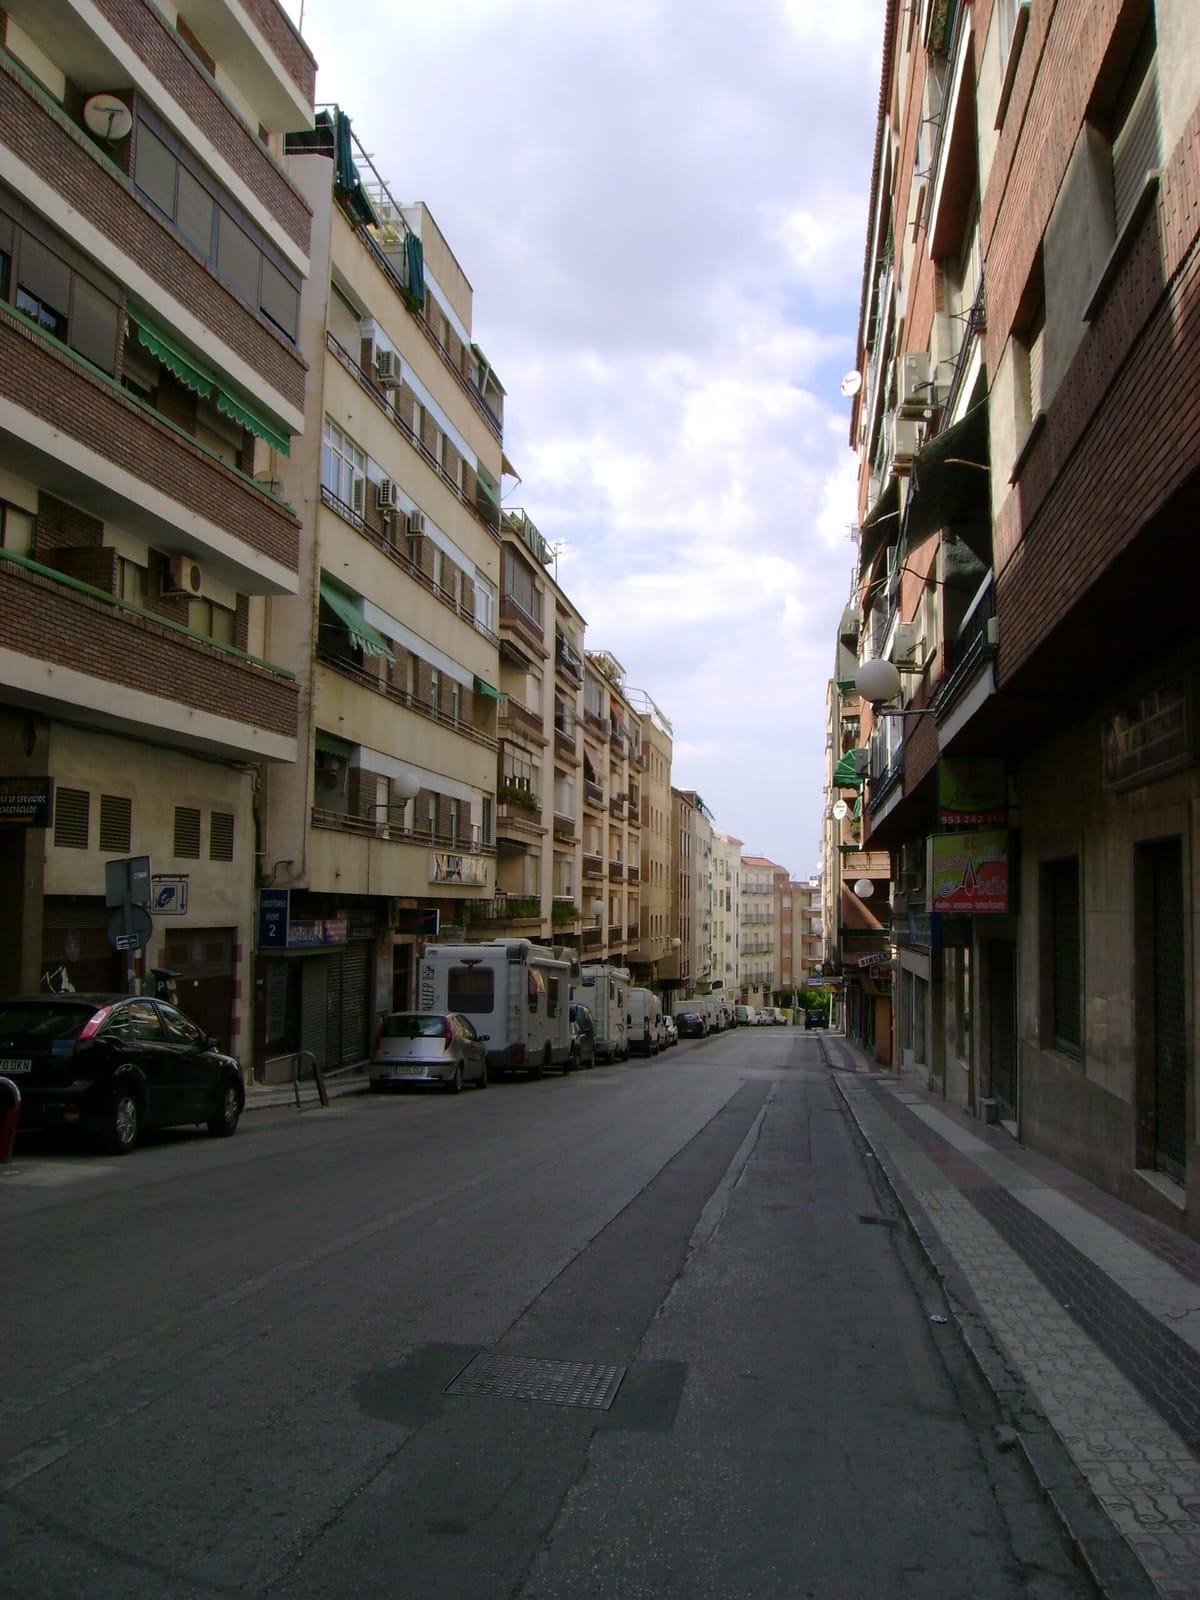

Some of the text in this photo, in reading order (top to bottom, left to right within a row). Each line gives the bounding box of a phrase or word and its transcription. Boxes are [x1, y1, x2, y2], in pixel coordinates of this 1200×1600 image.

[940, 815, 960, 824] 953
[963, 815, 983, 824] 242
[268, 924, 276, 937] 2
[157, 980, 165, 992] P
[10, 1060, 30, 1070] DKN
